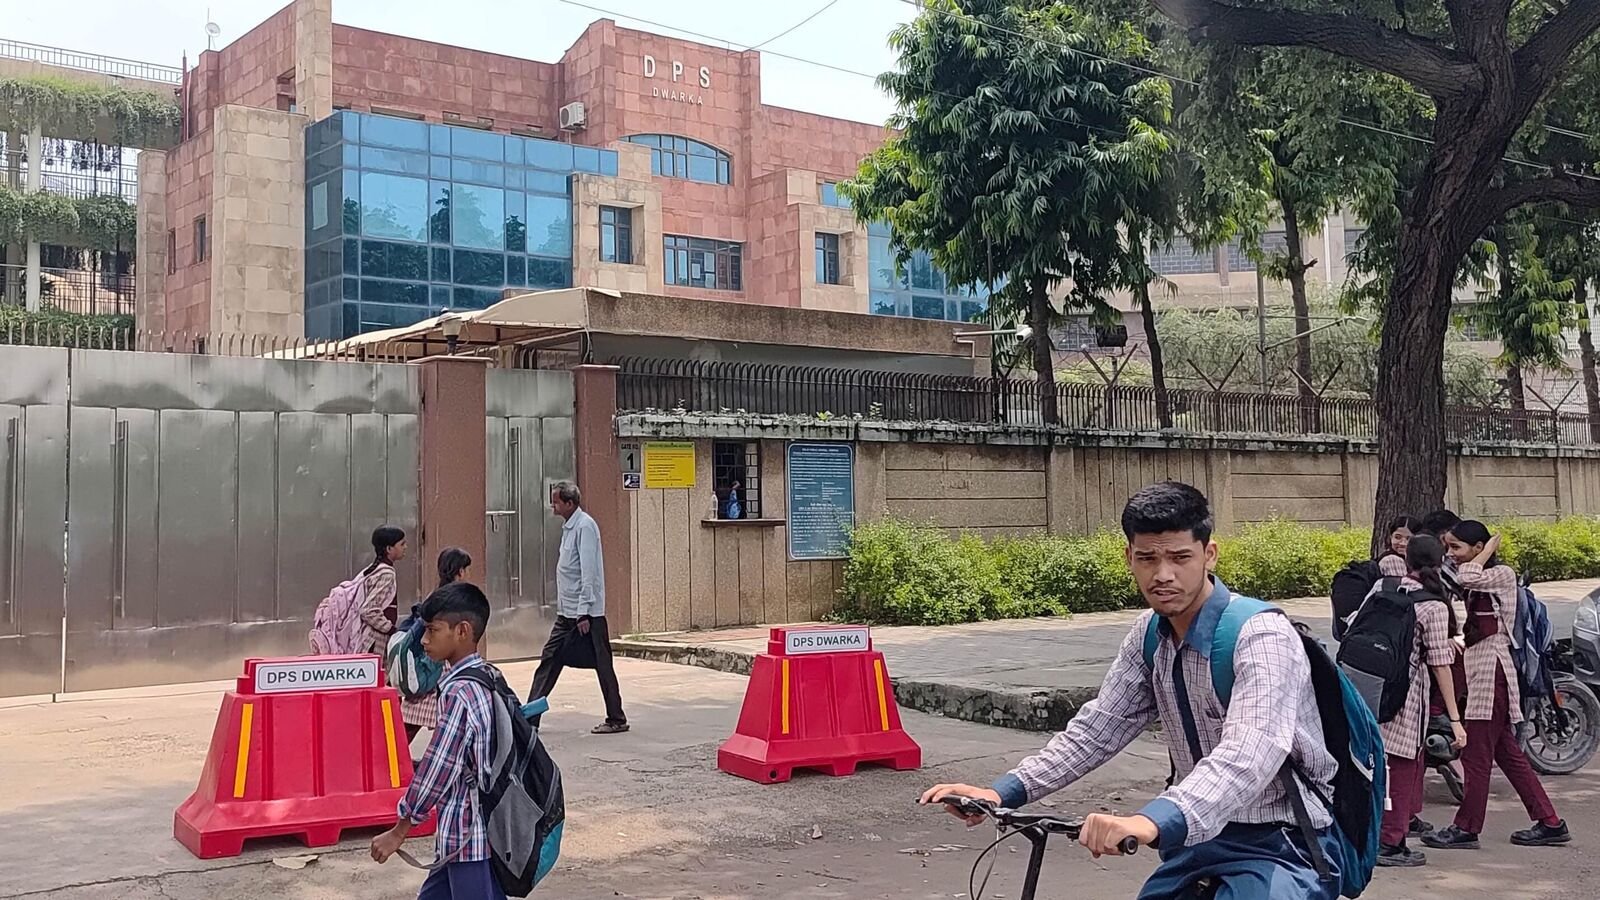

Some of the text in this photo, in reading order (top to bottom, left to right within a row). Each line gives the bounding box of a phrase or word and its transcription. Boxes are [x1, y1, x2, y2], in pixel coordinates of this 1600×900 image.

[652, 87, 703, 105] DWARKA
[626, 452, 634, 470] 1
[792, 635, 861, 648] DPS DWARKA
[267, 668, 367, 684] DPS DWARKA
